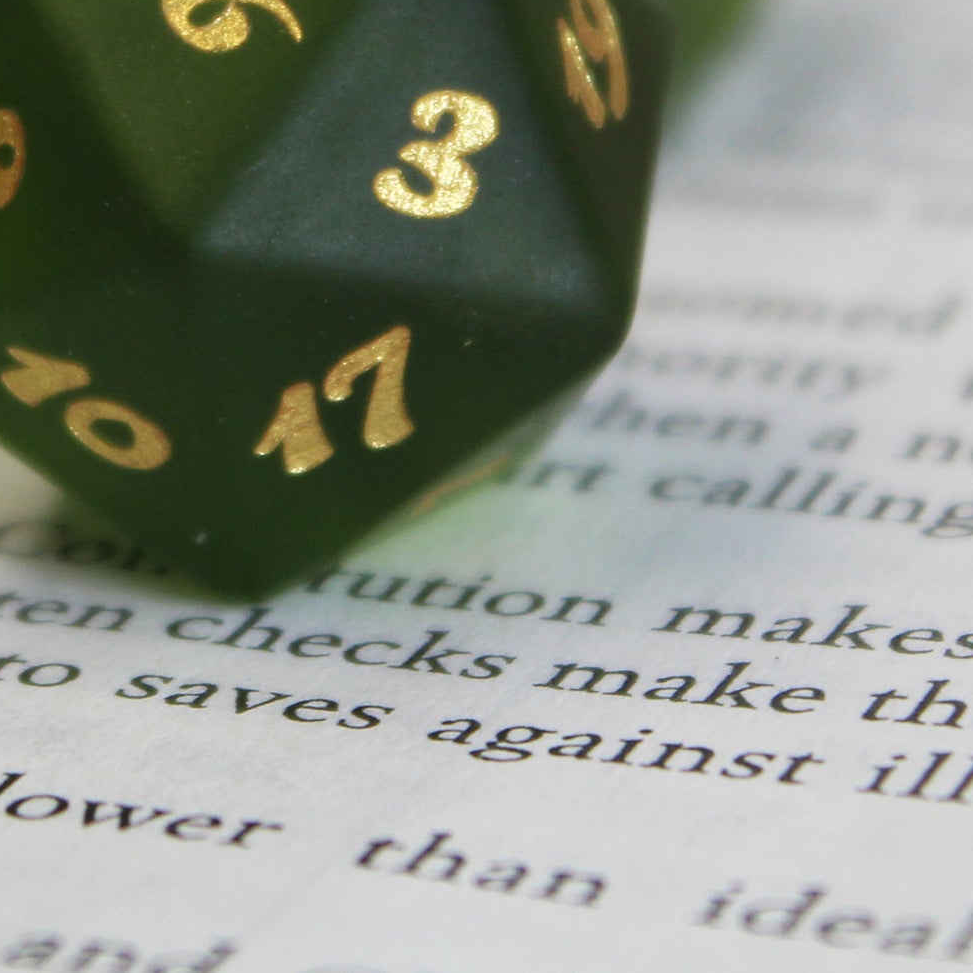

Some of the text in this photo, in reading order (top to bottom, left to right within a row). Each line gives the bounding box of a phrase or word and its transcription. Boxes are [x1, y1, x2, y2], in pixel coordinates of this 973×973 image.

[373, 89, 500, 219] 3
[0, 345, 173, 471] 10
[253, 325, 415, 476] 17
[587, 387, 771, 447] hen
[647, 465, 973, 539] calling
[163, 605, 517, 680] checks
[533, 661, 826, 713] make
[649, 604, 973, 659] makes
[114, 673, 395, 730] saves
[427, 717, 825, 785] against
[353, 831, 609, 909] than
